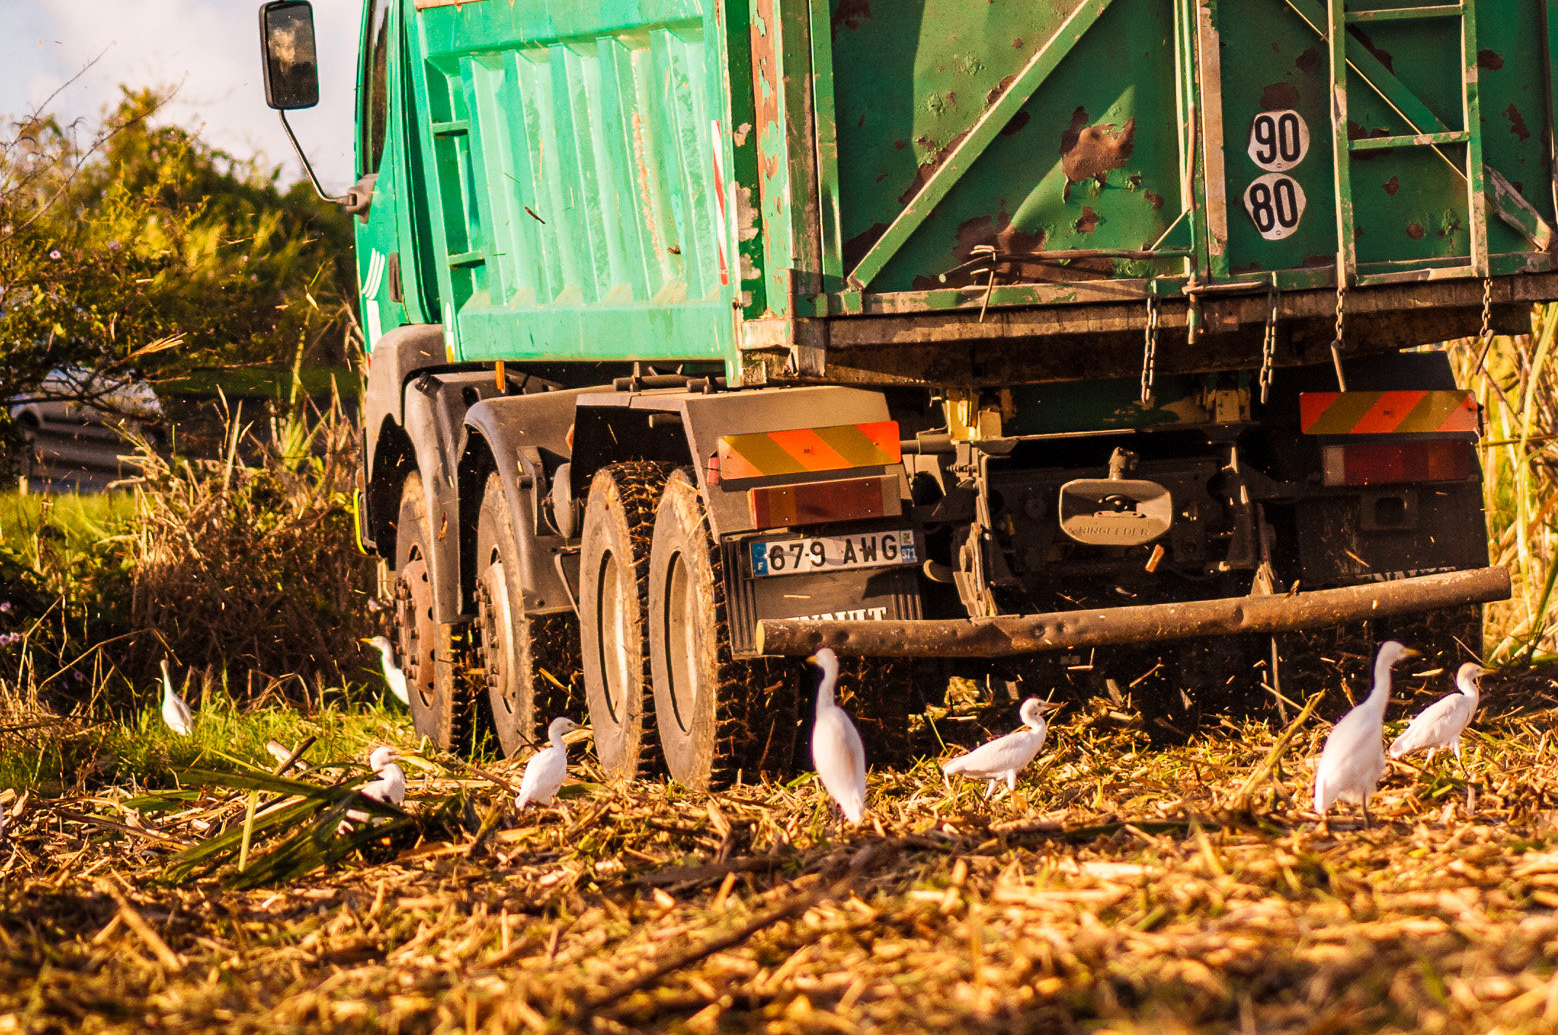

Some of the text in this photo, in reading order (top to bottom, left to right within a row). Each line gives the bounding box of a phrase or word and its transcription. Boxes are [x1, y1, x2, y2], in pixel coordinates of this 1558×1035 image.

[1254, 112, 1301, 164] 90
[1249, 178, 1299, 233] 80
[757, 561, 764, 571] F
[843, 534, 898, 565] AWG
